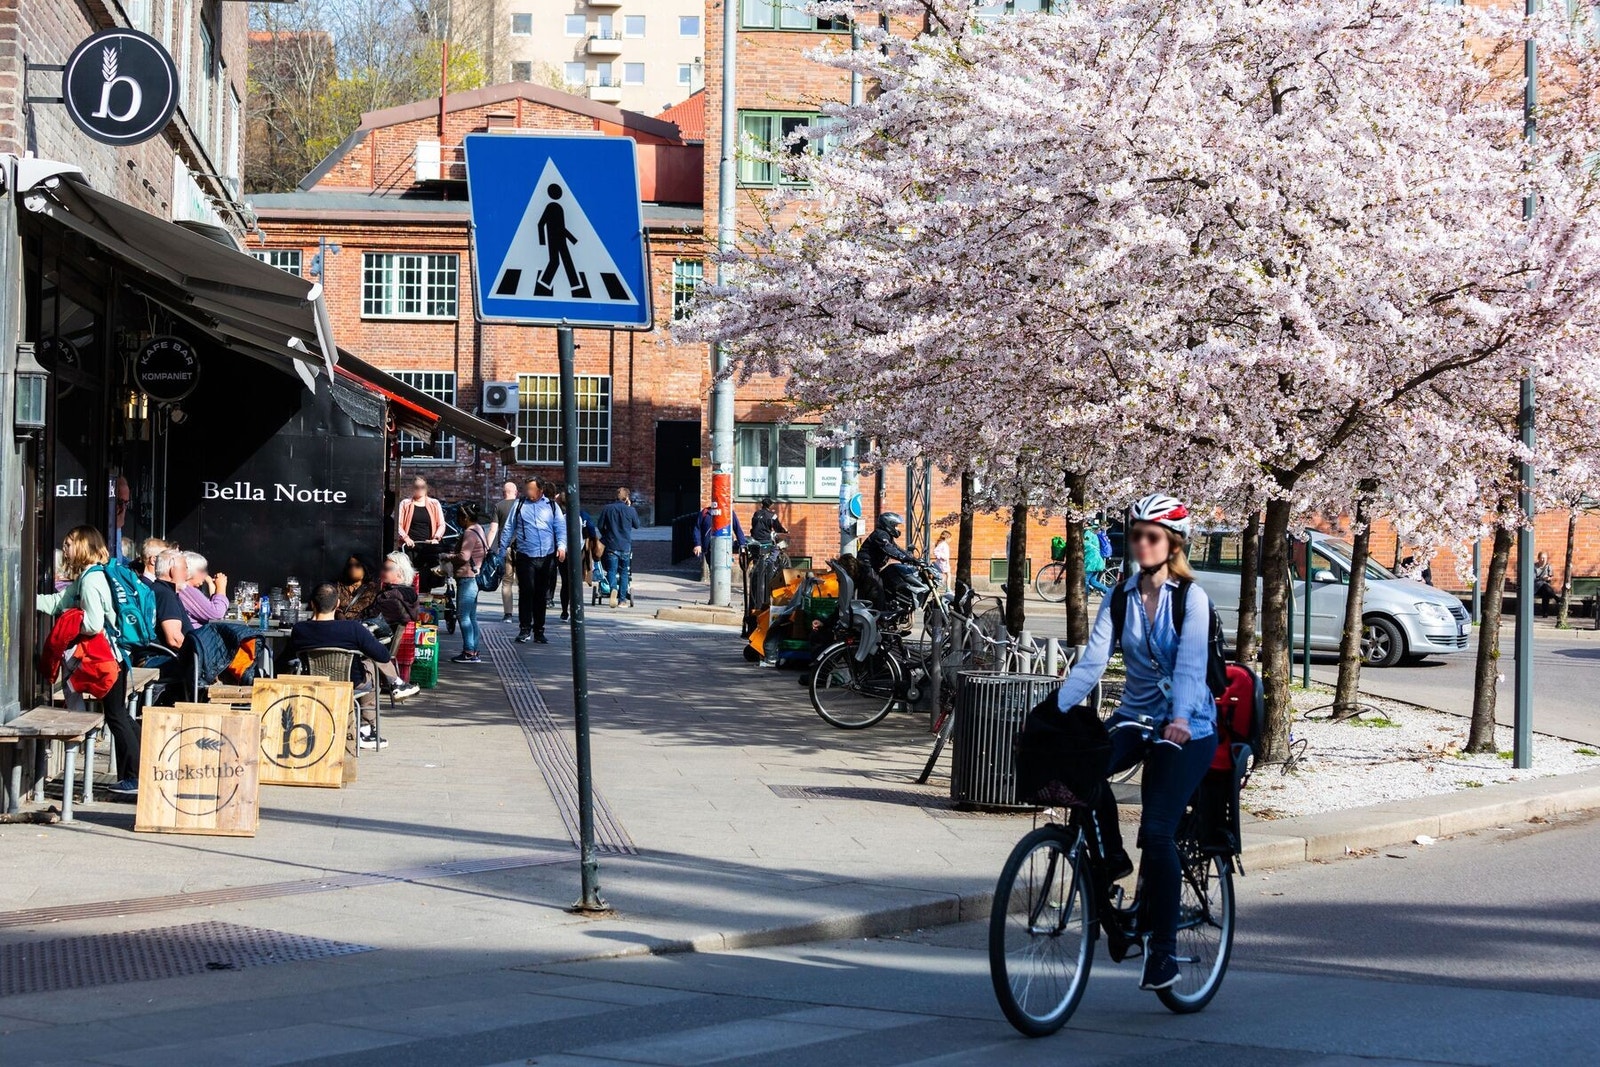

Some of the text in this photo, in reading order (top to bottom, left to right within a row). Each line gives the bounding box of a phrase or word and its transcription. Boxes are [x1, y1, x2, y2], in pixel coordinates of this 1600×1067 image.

[91, 45, 143, 122] b
[141, 341, 194, 365] KAFE BAR
[201, 481, 347, 504] Bella Notte
[277, 704, 315, 759] b
[152, 762, 245, 782] backstube
